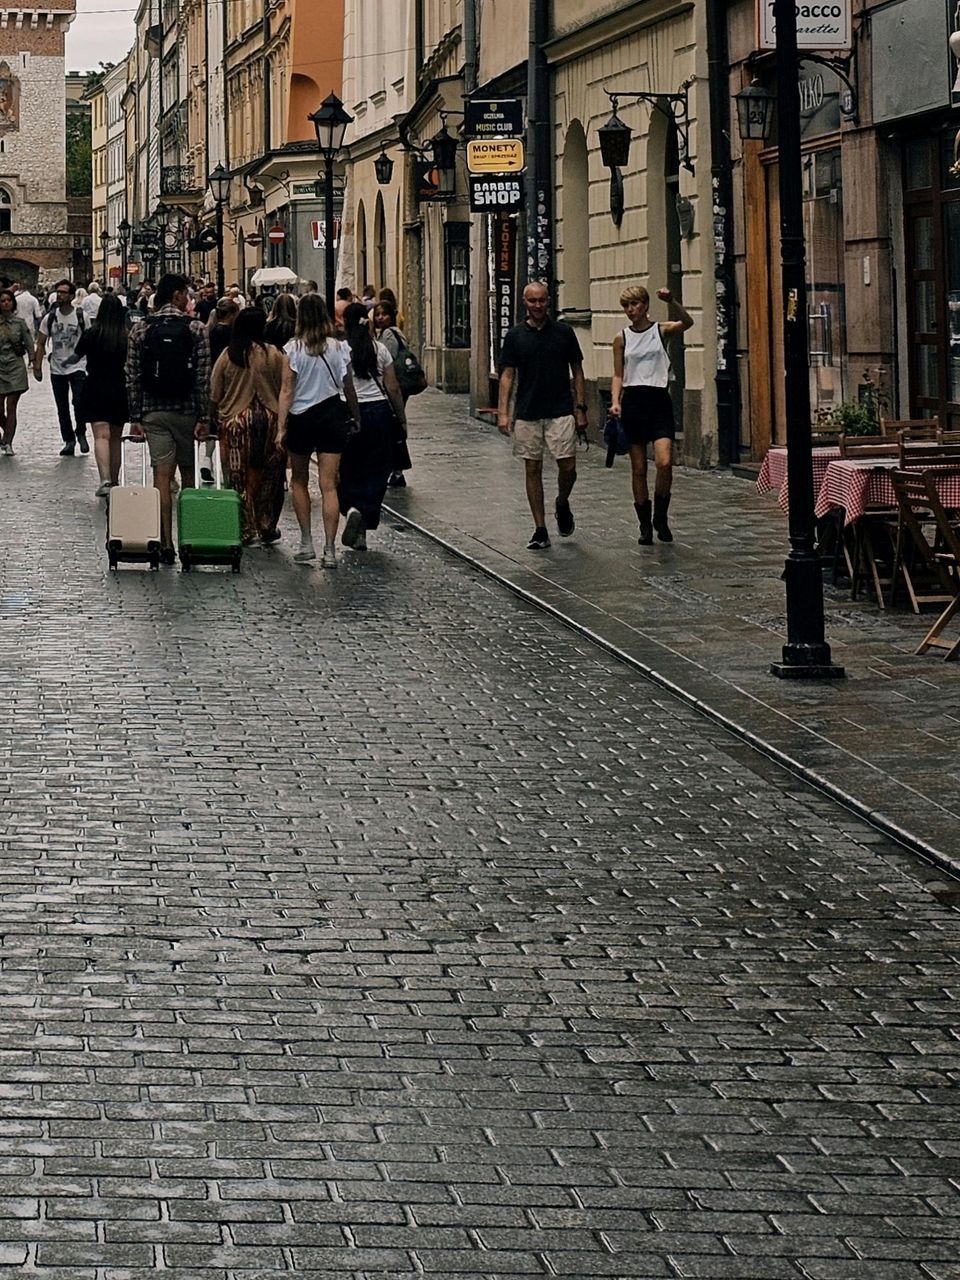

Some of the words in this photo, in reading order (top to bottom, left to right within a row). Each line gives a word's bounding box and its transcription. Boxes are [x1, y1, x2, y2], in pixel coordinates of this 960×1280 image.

[475, 123, 496, 132] MUSIC
[496, 122, 514, 132] CLUB
[472, 143, 517, 153] MONETY
[473, 181, 520, 192] BARBER
[473, 190, 521, 205] SHOP
[500, 222, 510, 271] COINS
